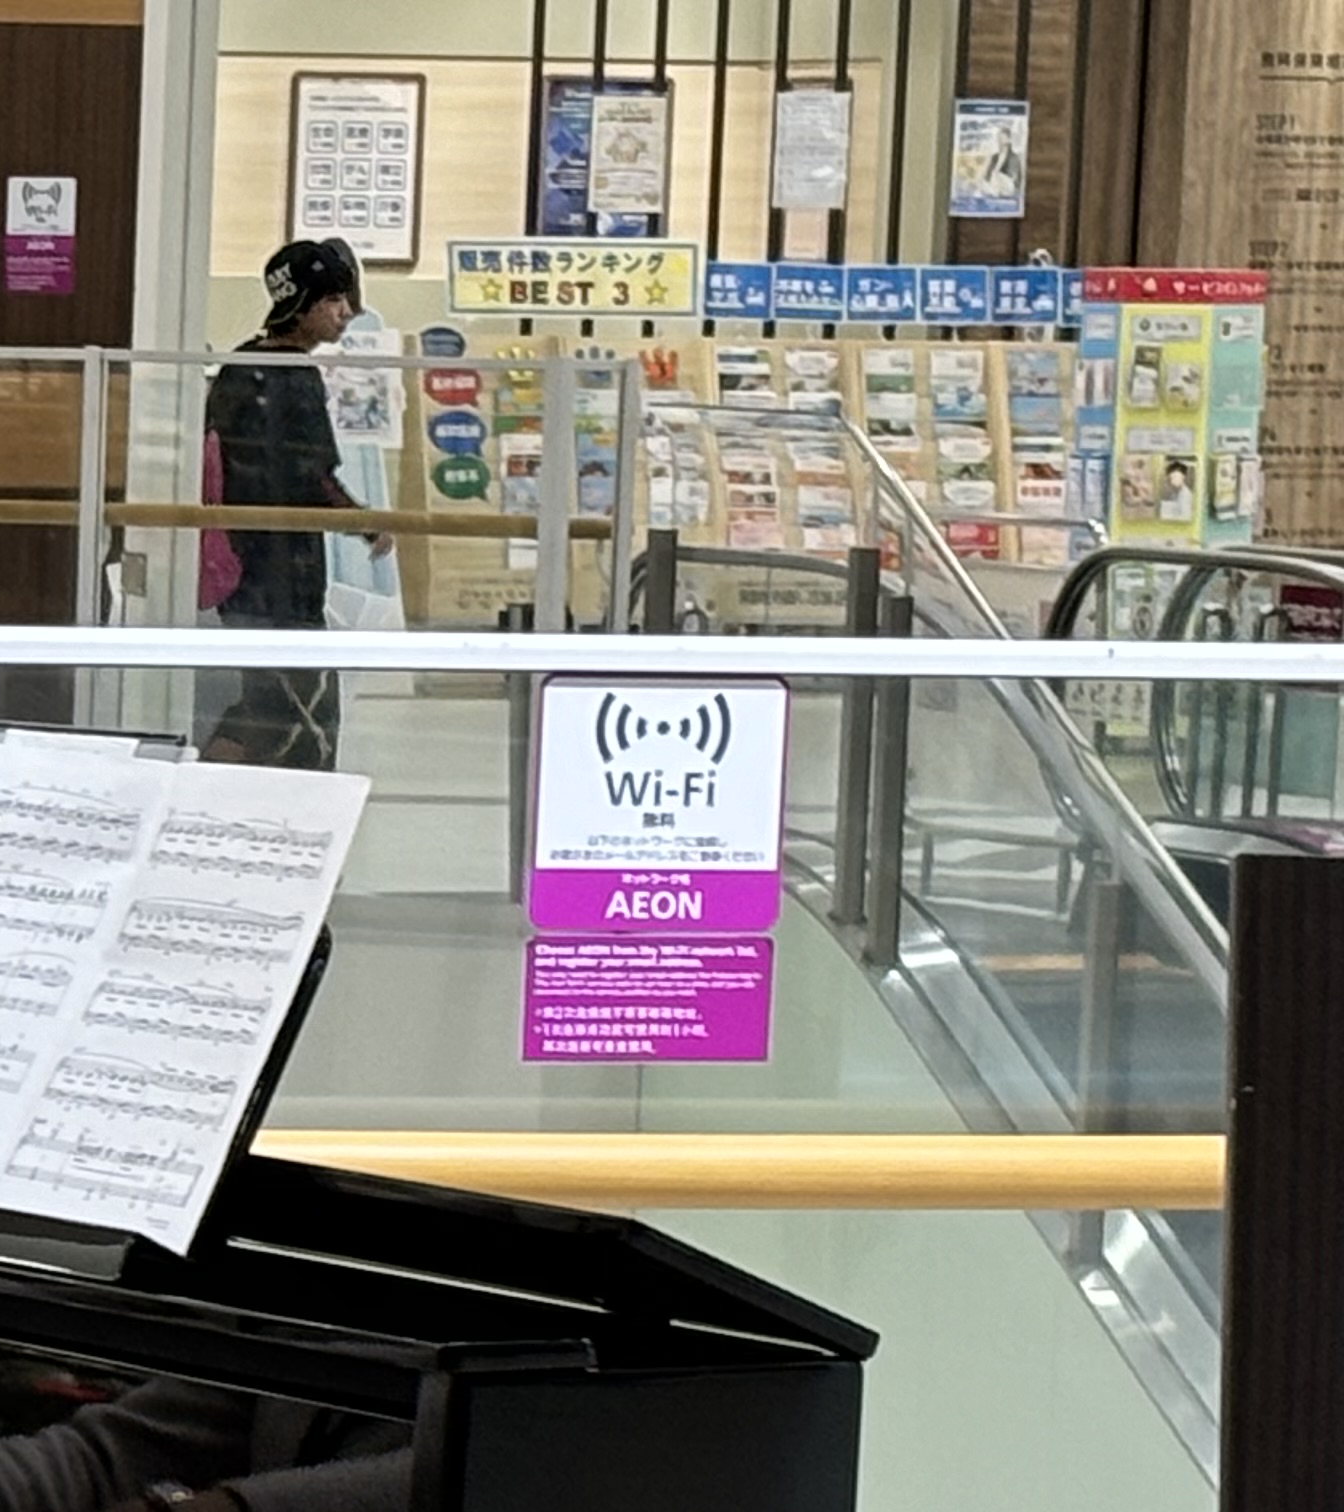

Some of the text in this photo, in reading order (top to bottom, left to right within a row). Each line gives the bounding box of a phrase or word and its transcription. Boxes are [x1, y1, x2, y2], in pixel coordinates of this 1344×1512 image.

[510, 281, 630, 305] BEST 3
[605, 769, 716, 807] Wi-Fi
[605, 890, 703, 920] AEON
